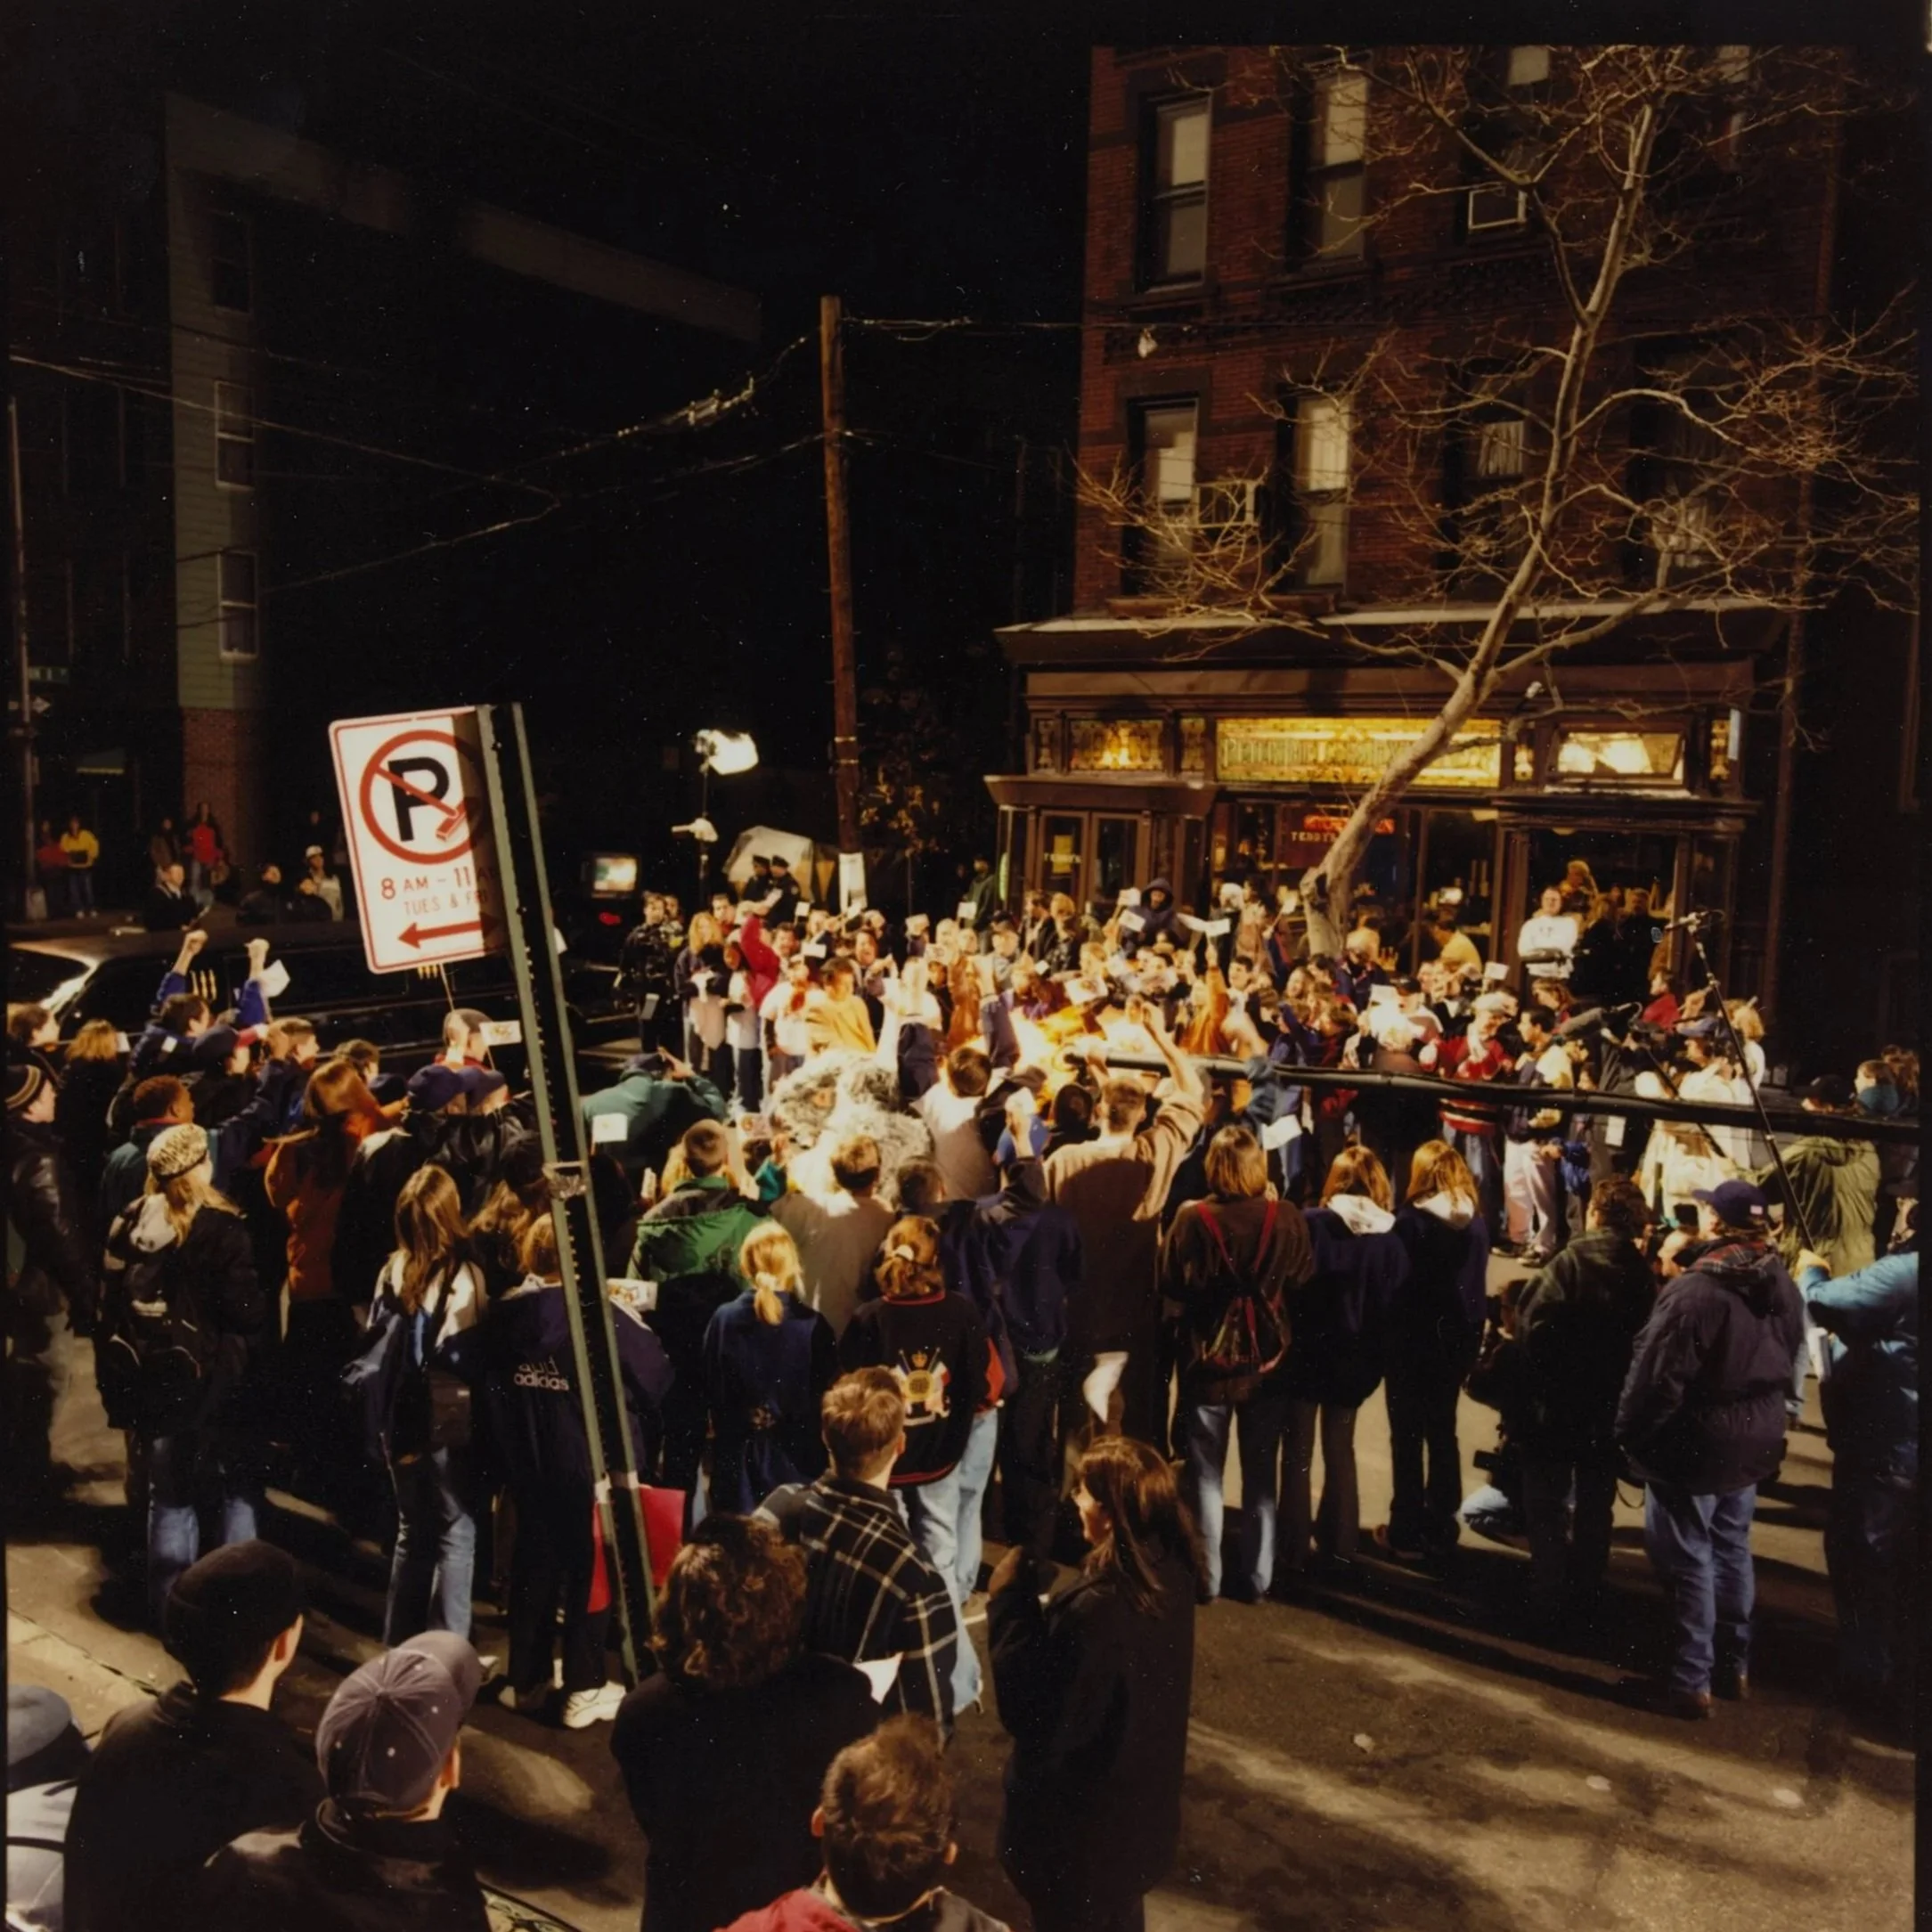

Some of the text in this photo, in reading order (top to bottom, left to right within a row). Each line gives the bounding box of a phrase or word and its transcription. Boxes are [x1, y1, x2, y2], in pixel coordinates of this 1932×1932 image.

[380, 876, 396, 900] 8
[403, 875, 428, 893] AM
[452, 866, 472, 888] 11
[403, 894, 441, 916] TUES
[449, 893, 459, 909] &
[513, 1371, 570, 1392] adidas
